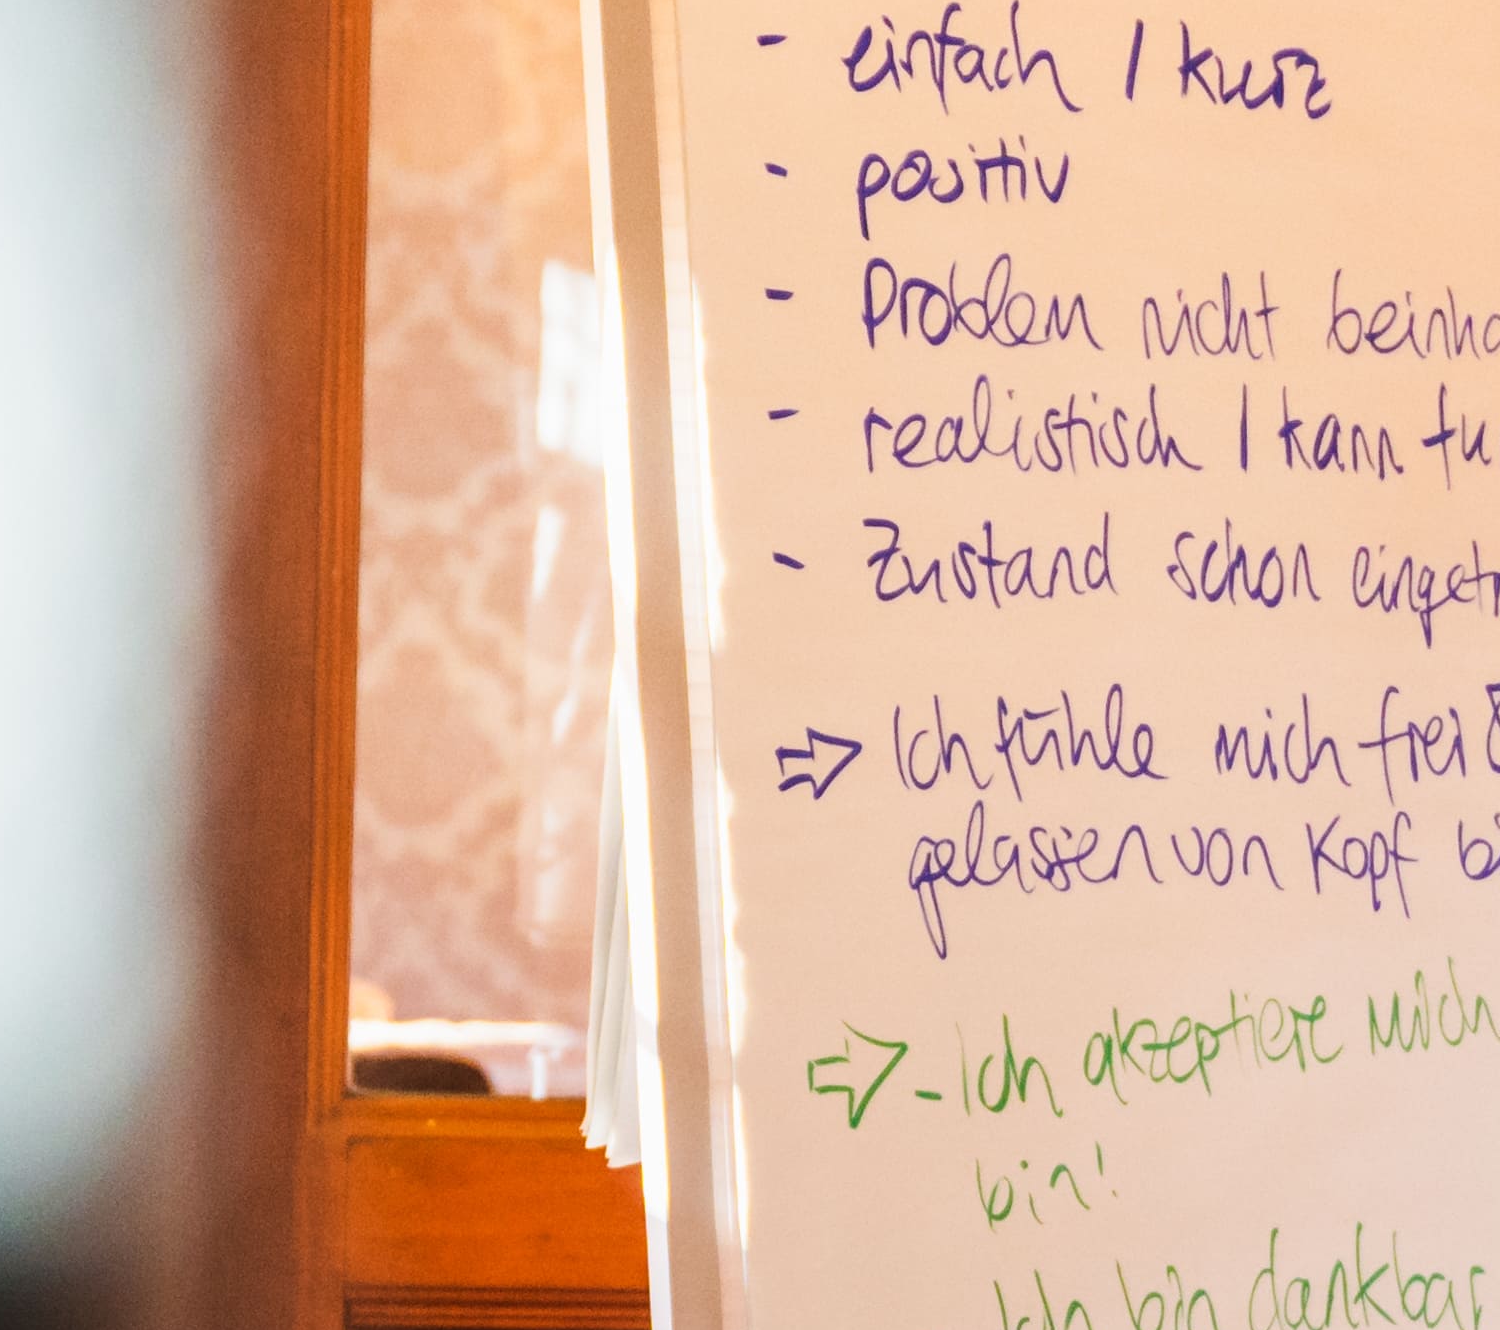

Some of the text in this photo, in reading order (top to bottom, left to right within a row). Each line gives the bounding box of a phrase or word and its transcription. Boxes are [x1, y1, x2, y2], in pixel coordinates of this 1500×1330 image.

[842, 0, 1082, 113] einfach
[1178, 21, 1332, 120] kurz
[856, 135, 1070, 241] positiv
[861, 253, 1102, 350] Problem
[1143, 272, 1278, 360] nicht
[863, 374, 1203, 473] realistisch
[1277, 388, 1404, 481] kann
[862, 512, 1117, 608] Zustand
[1166, 519, 1320, 609] schon
[893, 695, 991, 791] Ich
[995, 683, 1166, 801] fühle
[1214, 693, 1352, 787] mich
[1358, 685, 1466, 802] frei
[908, 800, 1162, 960] gelassen
[1171, 826, 1282, 890] von
[1305, 811, 1416, 918] Kopf
[955, 1013, 1064, 1118] Ich
[1083, 987, 1343, 1105] akzeptiere
[975, 1141, 1118, 1234] bin!
